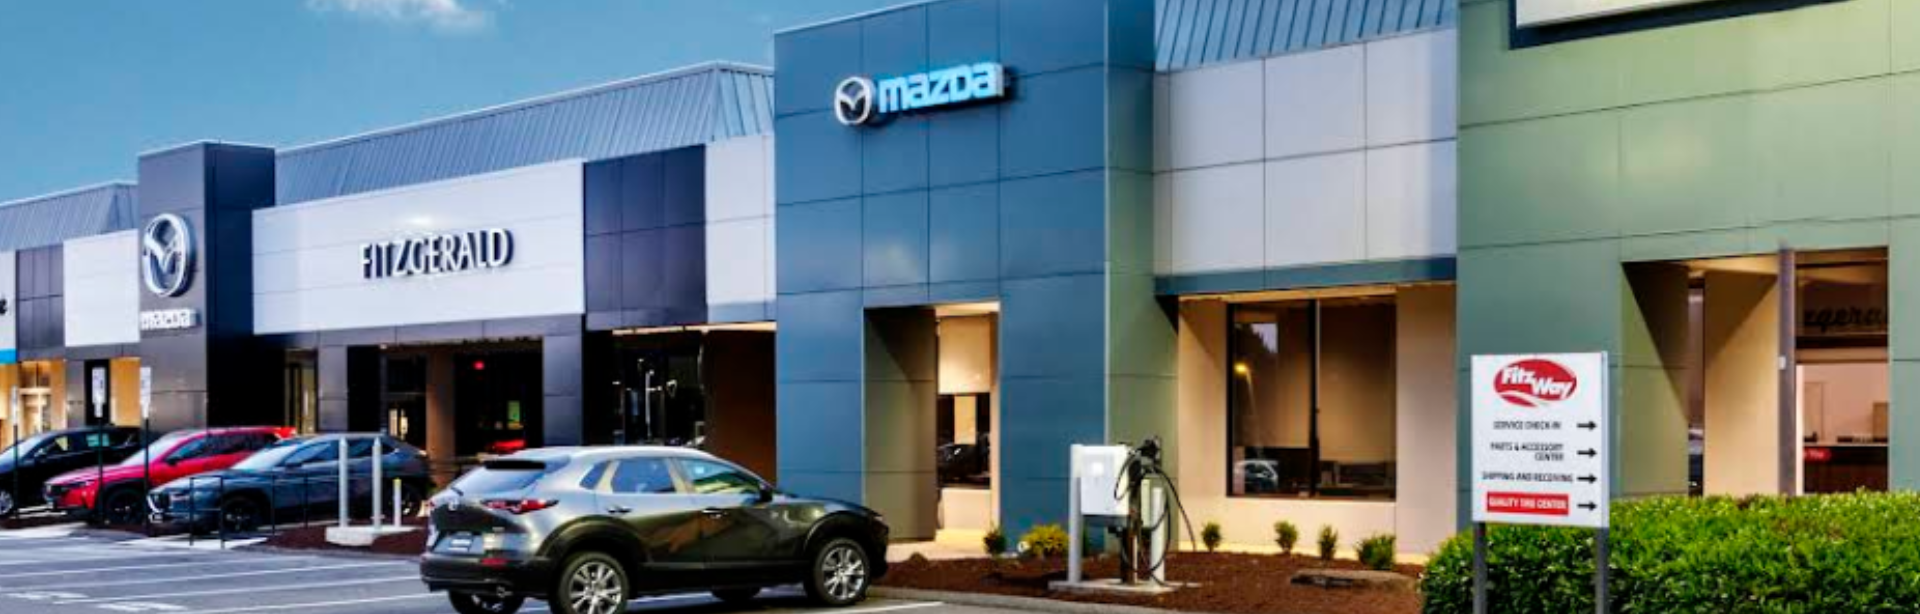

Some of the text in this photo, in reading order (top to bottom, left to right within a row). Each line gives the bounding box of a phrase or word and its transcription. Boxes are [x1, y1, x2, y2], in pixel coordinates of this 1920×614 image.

[878, 62, 1003, 113] mazda
[359, 228, 514, 279] FITZGERALD
[140, 309, 193, 331] mazda
[1501, 366, 1574, 399] Fitz Way
[1493, 421, 1523, 430] SERVICE
[1490, 442, 1513, 451] PARTS
[1521, 443, 1563, 451] ACCESSORY
[1535, 453, 1564, 461] CENTER
[1482, 471, 1573, 482] SHIPPING AND RECEIVING
